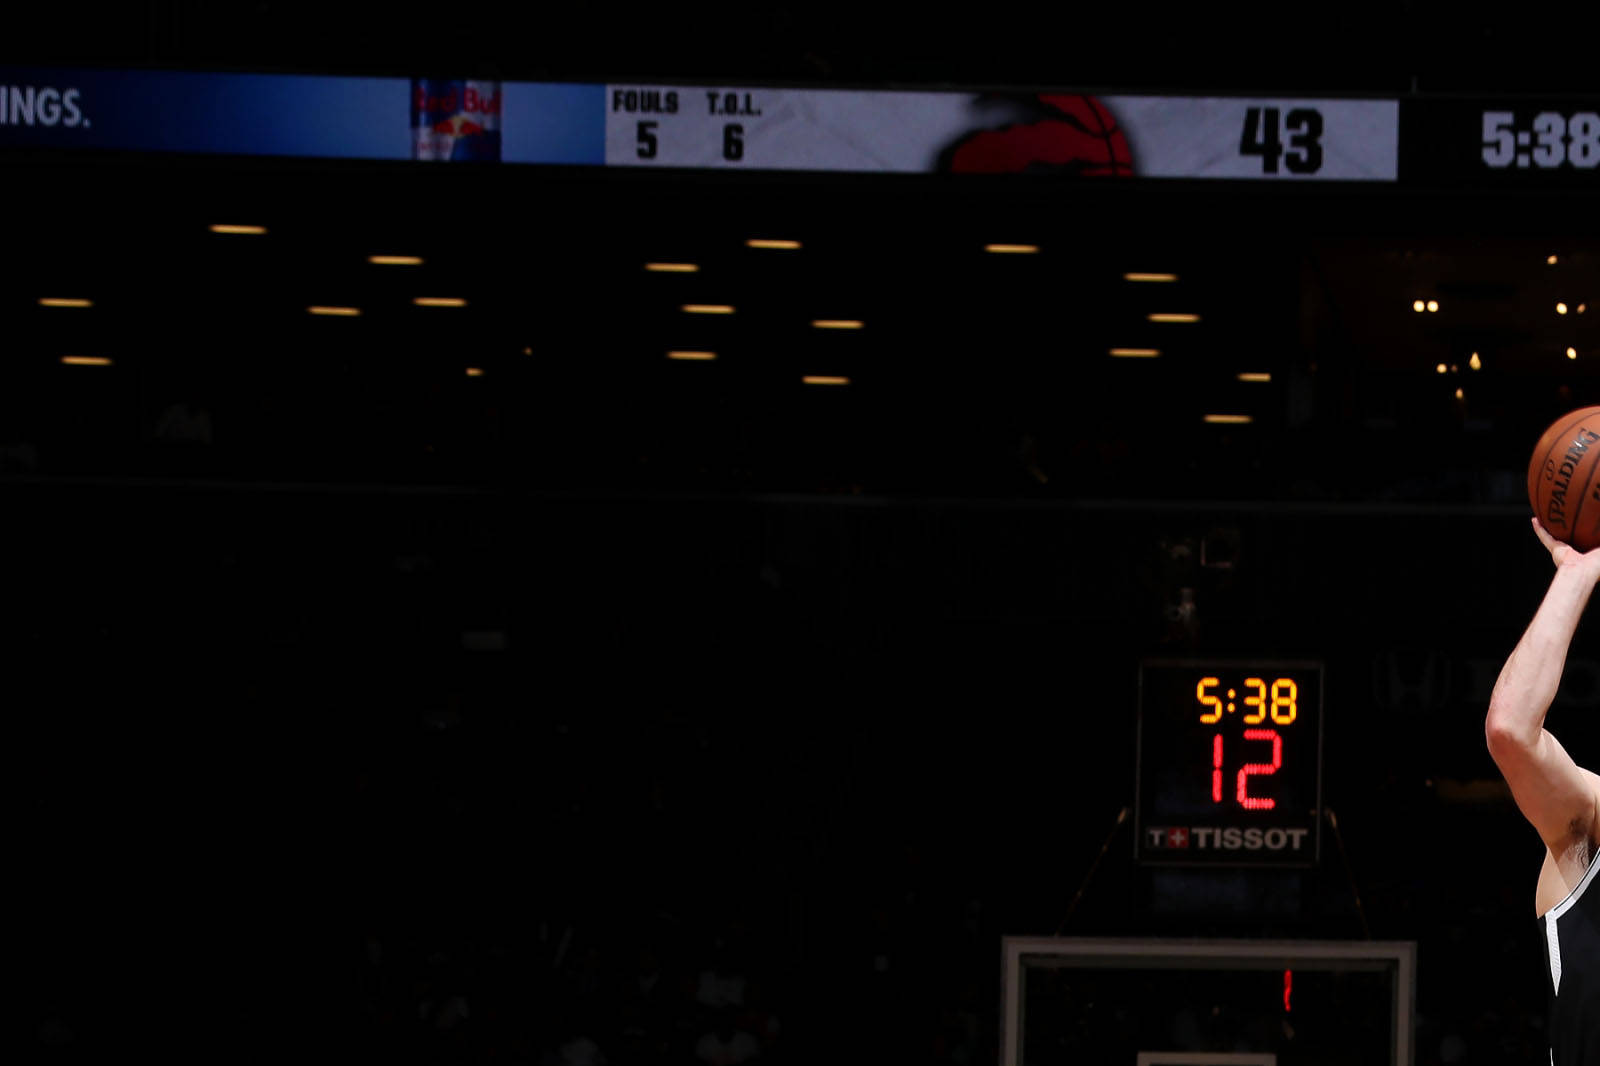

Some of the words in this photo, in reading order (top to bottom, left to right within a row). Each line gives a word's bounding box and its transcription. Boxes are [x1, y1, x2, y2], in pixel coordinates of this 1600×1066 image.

[613, 89, 678, 113] FOULS
[706, 92, 762, 115] T.O.L.
[637, 121, 658, 159] 5
[723, 124, 744, 161] 6
[1239, 107, 1323, 175] 43
[1196, 676, 1297, 725] 5:38
[1209, 728, 1282, 810] 12
[1191, 827, 1308, 850] TISSOT
